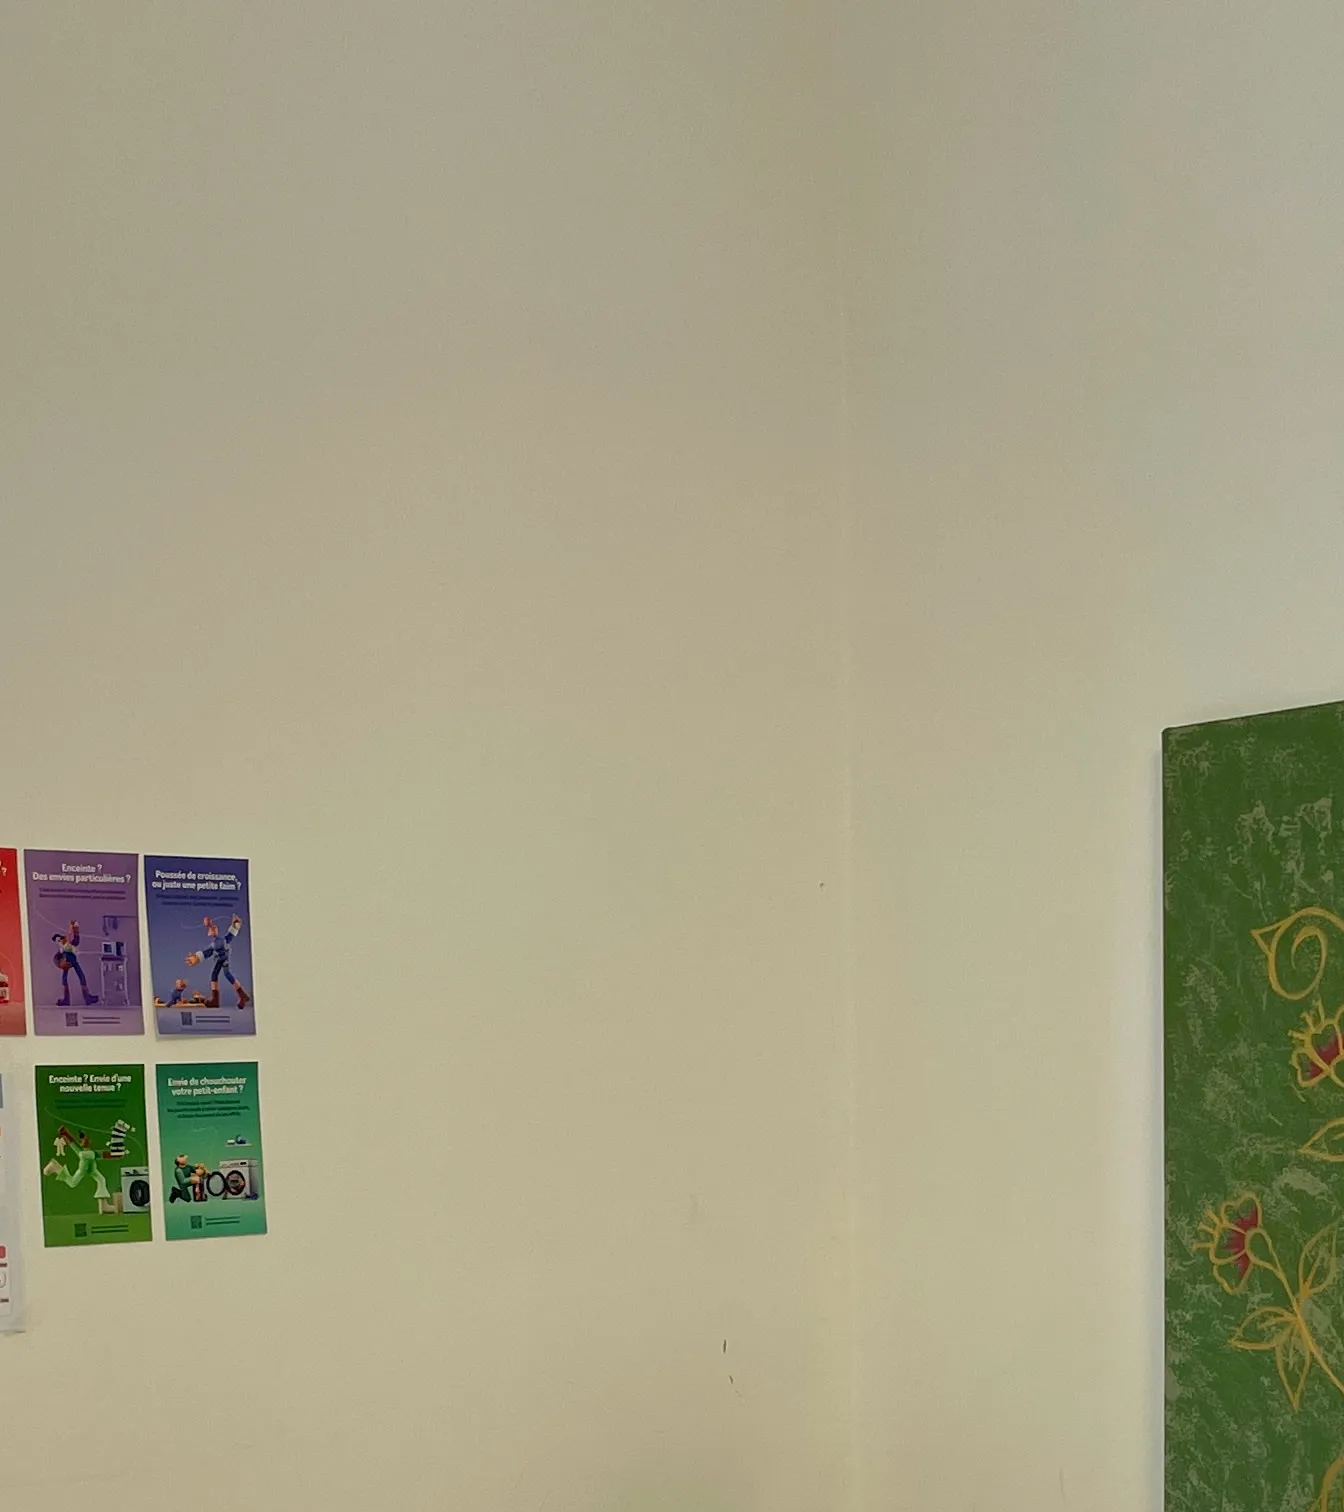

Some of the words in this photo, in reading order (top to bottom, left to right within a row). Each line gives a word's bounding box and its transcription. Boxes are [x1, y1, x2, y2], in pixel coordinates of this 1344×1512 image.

[62, 863, 96, 873] Enceinte
[32, 871, 48, 880] Des
[49, 874, 74, 882] envies
[75, 873, 125, 883] particulières
[156, 870, 186, 879] Poussée
[187, 871, 196, 880] de
[162, 880, 181, 890] juste
[197, 882, 218, 891] petite
[49, 1075, 82, 1084] Enceinte
[89, 1074, 110, 1083] Envie
[111, 1073, 132, 1082] d'une
[168, 1077, 188, 1086] Envie
[189, 1077, 199, 1085] de
[200, 1076, 246, 1085] chouchouter
[60, 1083, 92, 1092] nouvelle
[93, 1084, 115, 1092] tenue
[171, 1088, 192, 1096] votre
[193, 1085, 238, 1097] petit-enfant
